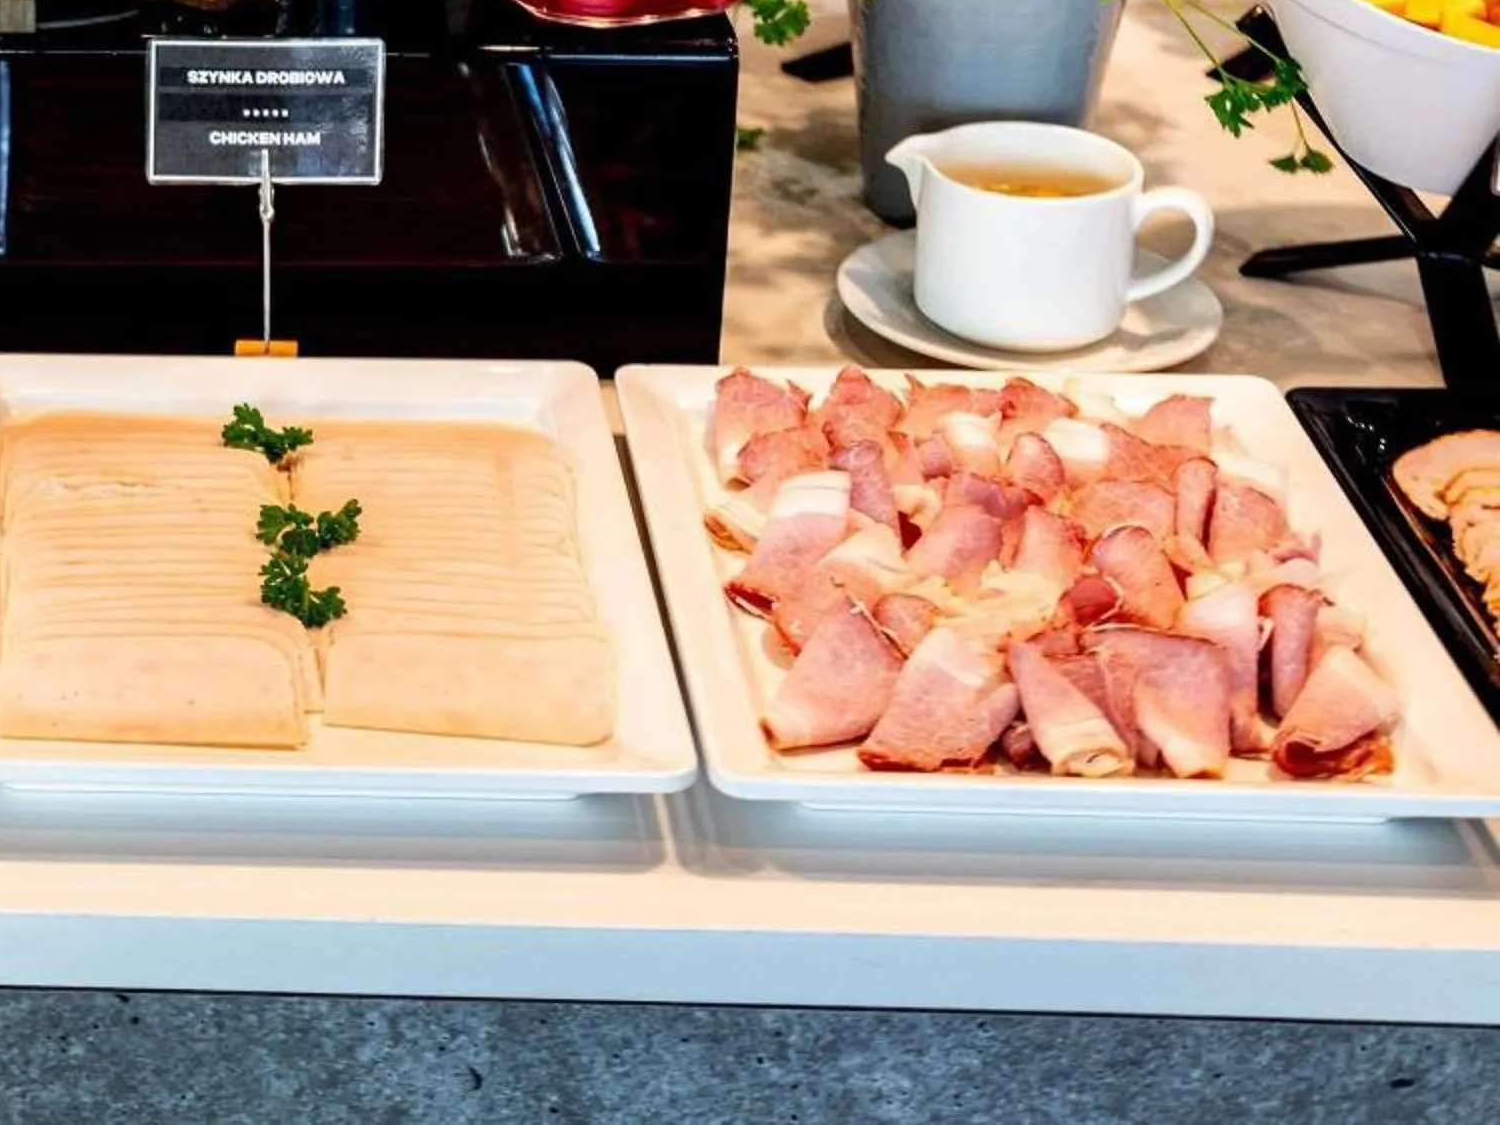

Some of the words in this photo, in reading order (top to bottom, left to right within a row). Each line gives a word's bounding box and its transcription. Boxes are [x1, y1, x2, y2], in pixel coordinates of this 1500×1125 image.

[187, 70, 253, 84] SZYNKA
[256, 70, 345, 84] DROBIOWA
[209, 130, 281, 145] CHICKEN
[284, 131, 321, 145] HAM
